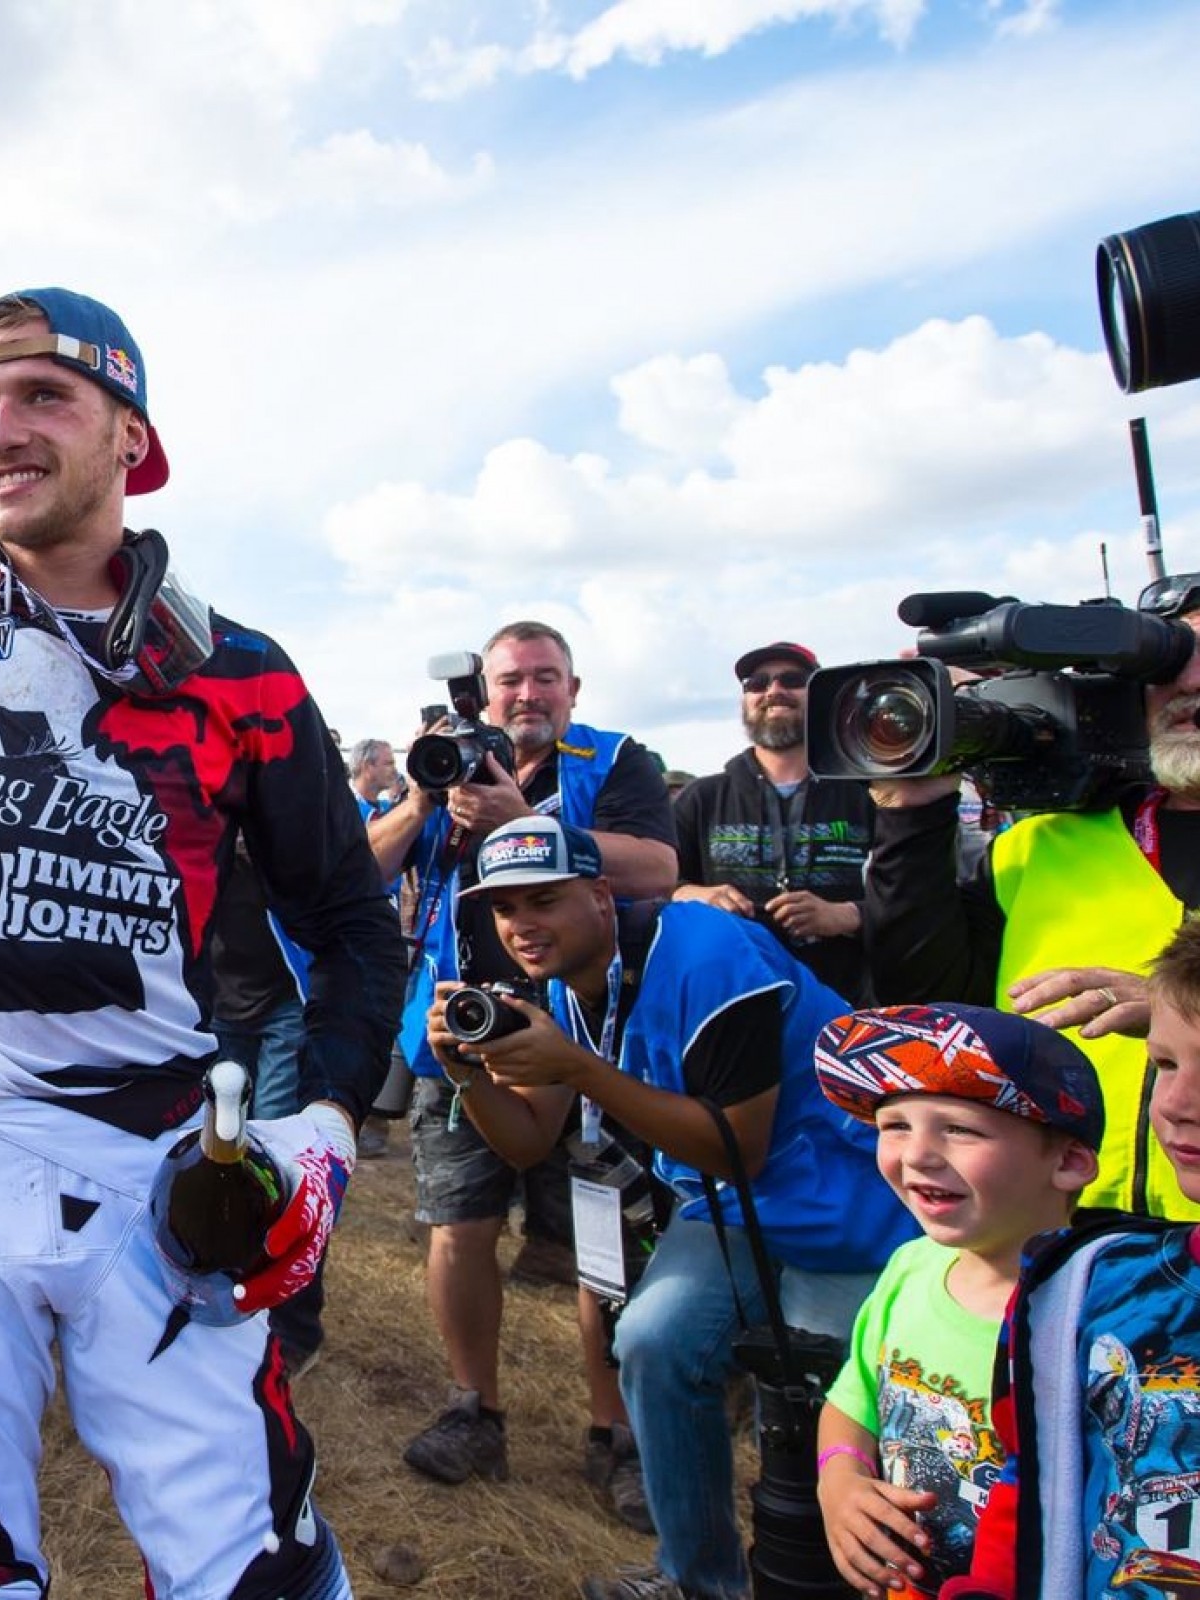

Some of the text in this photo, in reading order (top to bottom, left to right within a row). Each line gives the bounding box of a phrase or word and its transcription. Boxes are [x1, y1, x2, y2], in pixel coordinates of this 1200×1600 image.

[29, 775, 169, 848] Eagle
[12, 846, 181, 909] JIMMY
[7, 893, 170, 950] JOHN'S
